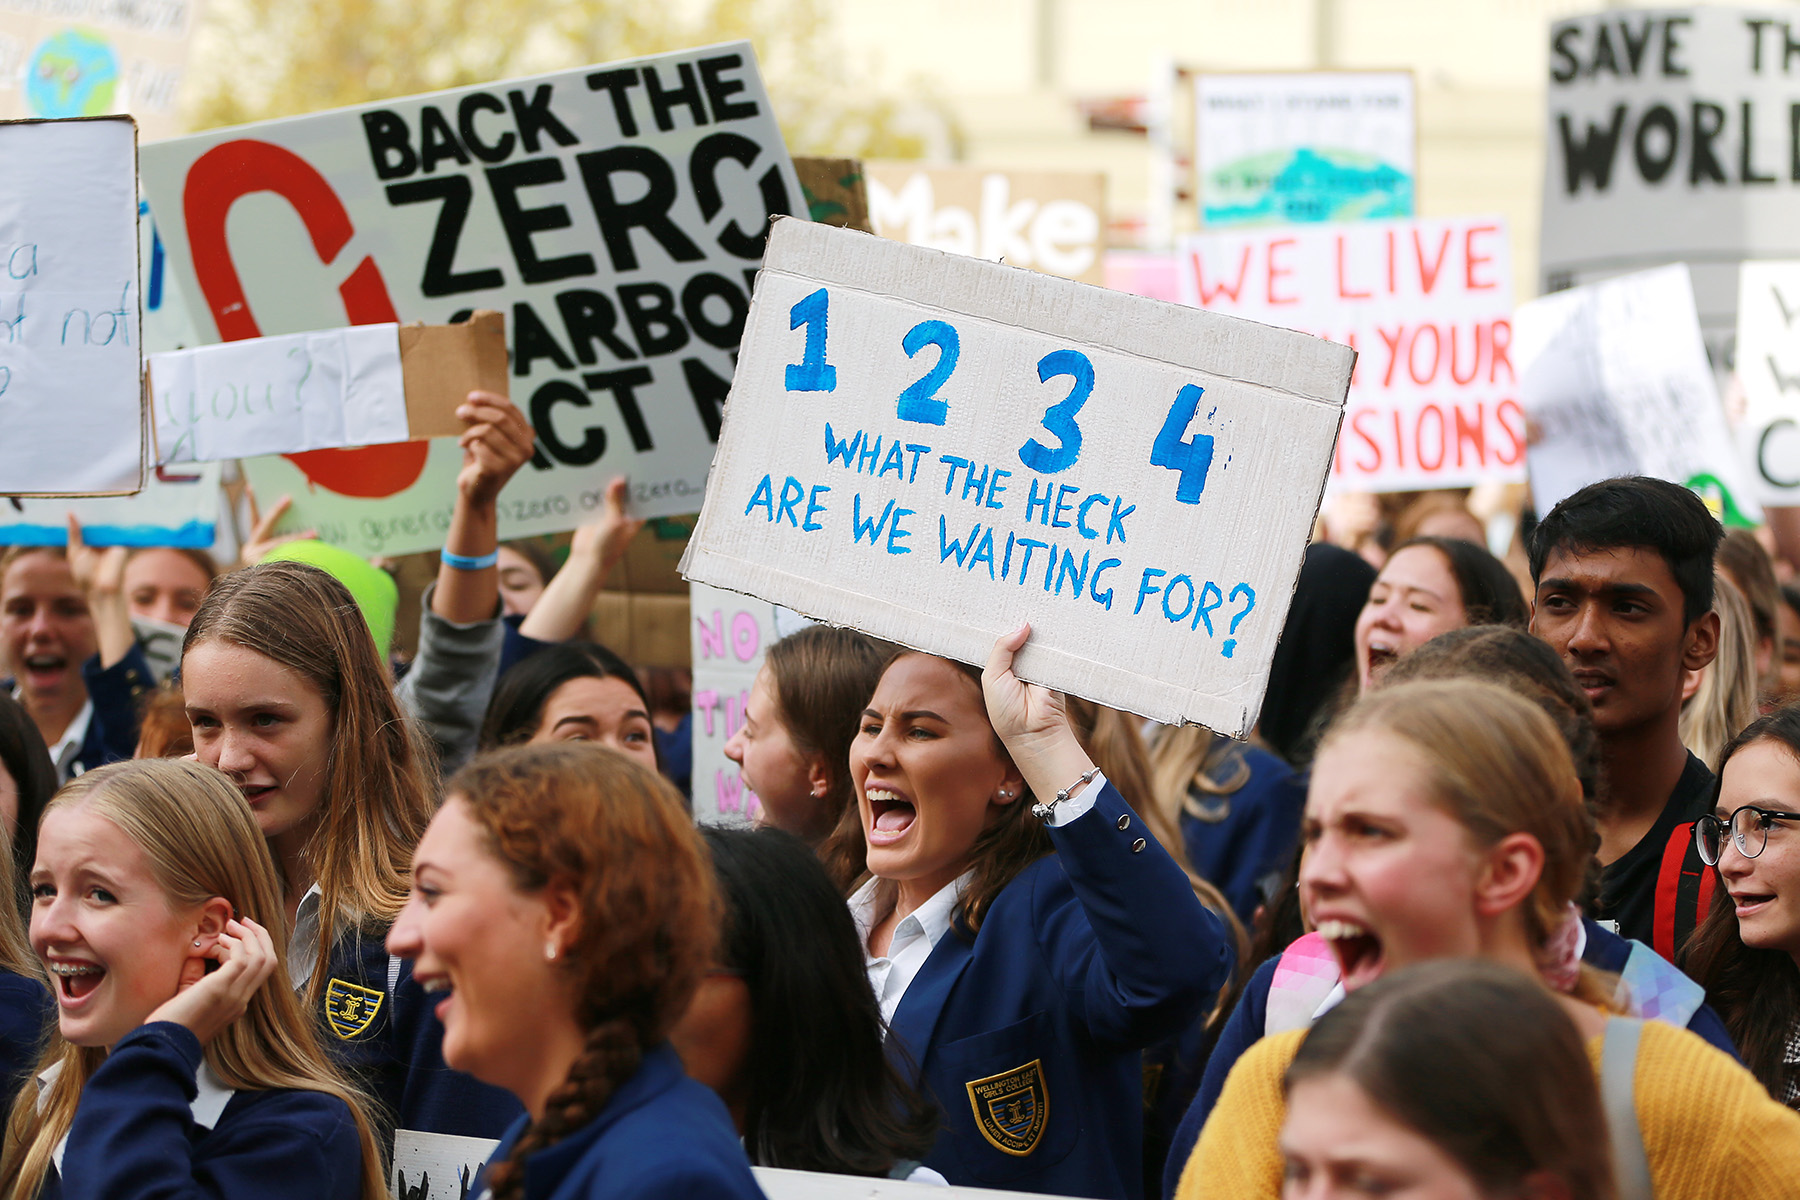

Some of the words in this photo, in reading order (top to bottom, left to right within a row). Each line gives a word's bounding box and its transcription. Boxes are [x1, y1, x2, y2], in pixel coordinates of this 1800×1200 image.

[1552, 17, 1692, 84] SAVE
[361, 84, 580, 181] BACK
[586, 54, 759, 138] THE
[385, 131, 794, 298] ZERO
[867, 172, 1099, 276] Make
[1192, 239, 1299, 306] WE
[1337, 226, 1497, 299] LIVE
[61, 280, 131, 346] not
[448, 268, 758, 377] ARBO
[1377, 319, 1516, 388] YOUR
[785, 288, 836, 393] 1
[896, 319, 960, 426] 2
[1019, 350, 1094, 474] 3
[1150, 384, 1215, 505] 4
[824, 422, 932, 485] WHAT
[940, 454, 1012, 509] THE
[1026, 477, 1137, 544] HECK
[745, 474, 832, 532] ARE
[853, 493, 916, 555] WE
[939, 513, 1122, 611] WAITING
[1134, 567, 1257, 659] FOR?
[696, 610, 759, 662] NO
[975, 1075, 1020, 1095] WELLINGTON
[1021, 1068, 1037, 1080] EAST
[1006, 1076, 1035, 1092] COLLEGE
[984, 1117, 1004, 1141] LUMEN
[1027, 1132, 1035, 1143] ET
